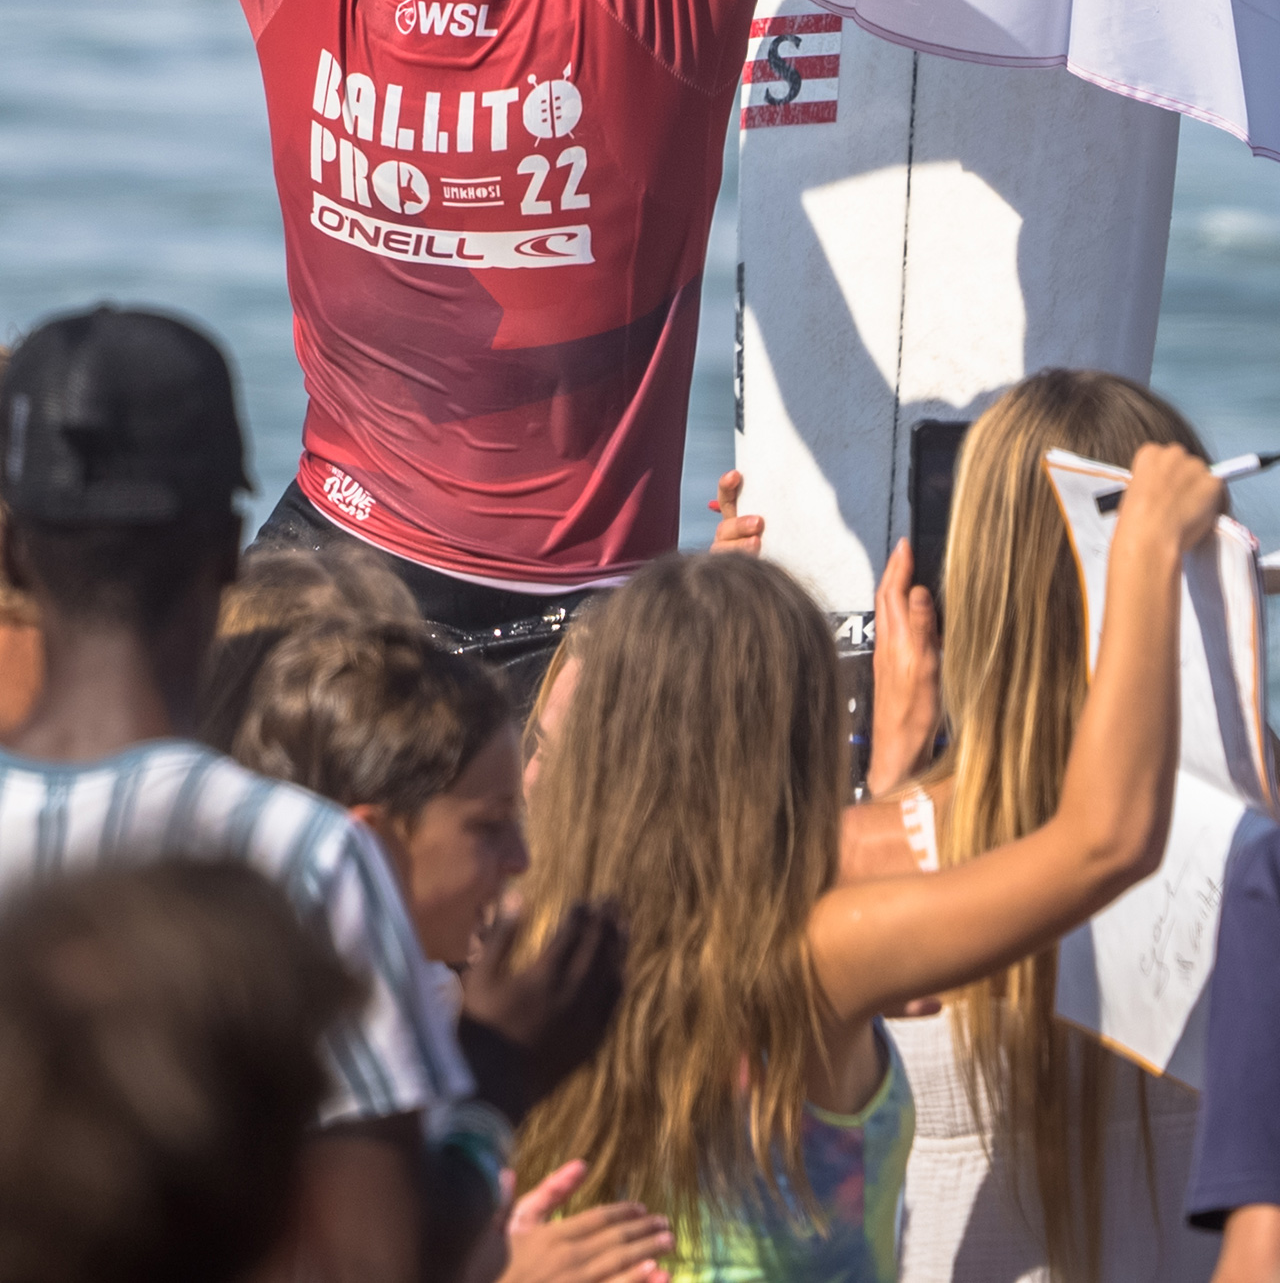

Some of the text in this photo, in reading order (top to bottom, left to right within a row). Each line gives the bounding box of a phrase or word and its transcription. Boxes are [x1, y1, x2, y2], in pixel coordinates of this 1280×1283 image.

[418, 1, 498, 37] WSL
[312, 48, 583, 154] BALLITO
[764, 34, 802, 105] S
[310, 120, 431, 215] PRO
[517, 145, 591, 215] 22
[317, 205, 485, 261] O'NEILL
